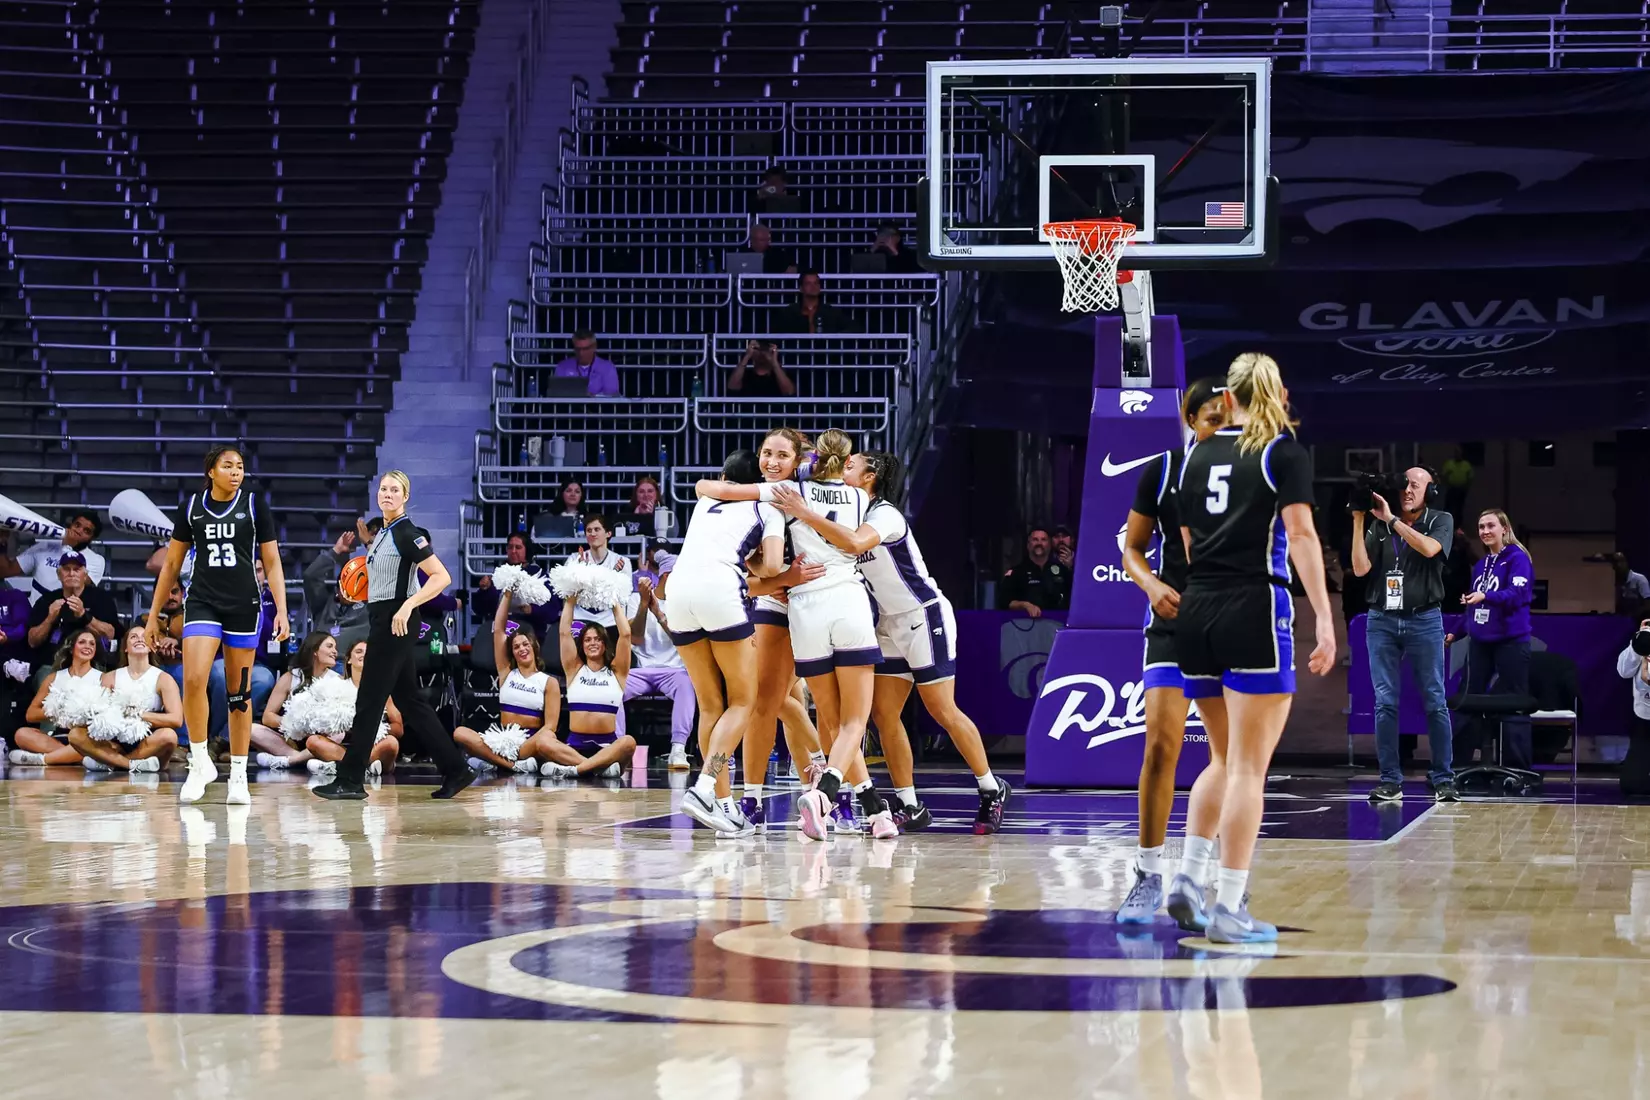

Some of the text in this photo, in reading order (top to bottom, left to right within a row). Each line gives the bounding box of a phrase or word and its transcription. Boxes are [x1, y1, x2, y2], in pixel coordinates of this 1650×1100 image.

[940, 247, 972, 256] SPALDING
[1298, 295, 1605, 330] GLAVAN
[1331, 361, 1557, 384] of Clay Center
[810, 487, 852, 505] SUNDELL
[1205, 464, 1233, 515] 5
[204, 523, 236, 540] EIU
[207, 543, 237, 567] 23
[508, 680, 537, 694] Wildcats
[579, 676, 609, 687] Wildcats
